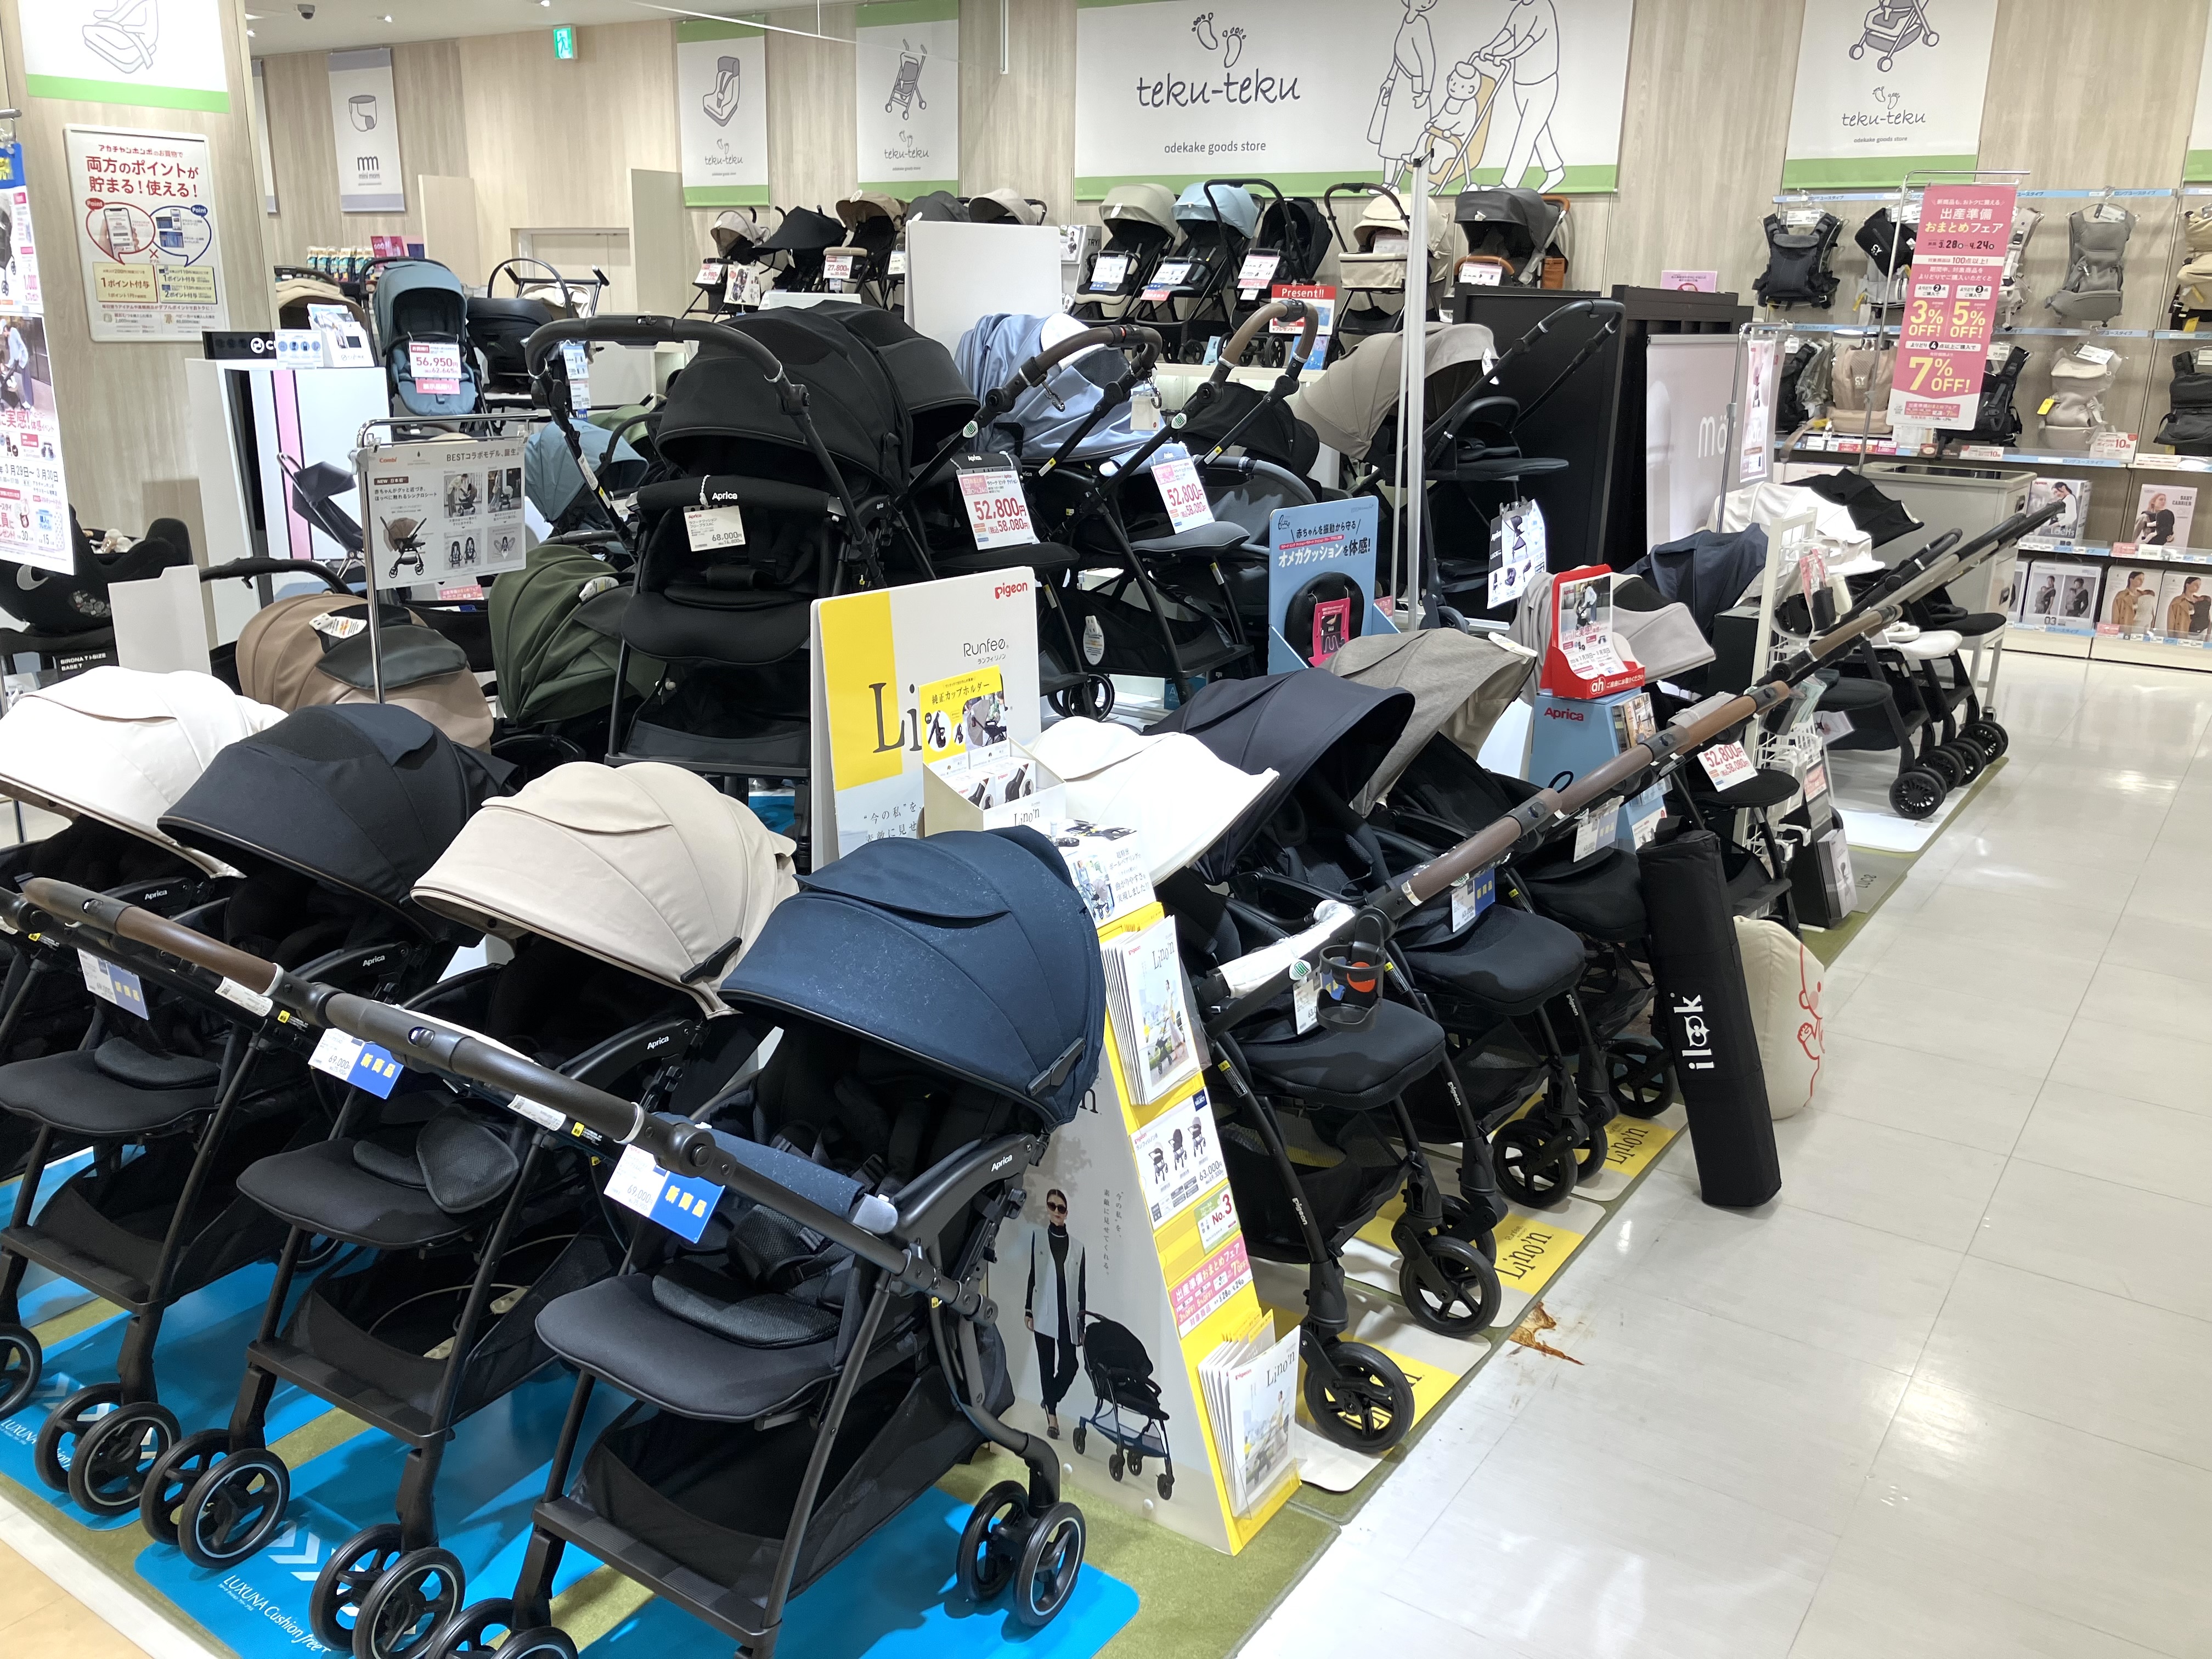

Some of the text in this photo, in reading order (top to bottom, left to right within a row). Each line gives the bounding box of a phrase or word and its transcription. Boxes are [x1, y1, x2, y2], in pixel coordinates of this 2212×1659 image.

[1137, 69, 1301, 108] teku-teku
[1842, 109, 1926, 126] teku-teku
[884, 147, 929, 160] teku-teku
[1164, 140, 1266, 155] odekake goods store
[86, 156, 199, 179] 両方のポイントが
[705, 155, 743, 166] teku-teku
[89, 176, 198, 198] 貯まる！使える！
[1940, 208, 1993, 220] 出産準備
[1925, 221, 2004, 234] おまとめフェア
[101, 278, 150, 289] 1ポイント付与
[1282, 287, 1324, 299] Present!!
[1910, 300, 1943, 324] 3%
[1952, 301, 1985, 326] 5%
[1909, 324, 1940, 337] OFF!
[1950, 326, 1983, 338] OFF!
[416, 357, 458, 368] 56,950円
[1909, 357, 1953, 391] 7%
[1931, 377, 1970, 392] OFF!
[447, 449, 520, 462] BESTコラボモデル、誕生。
[712, 492, 737, 501] Aprica
[1167, 483, 1204, 506] 52,800円
[973, 497, 1027, 521] 52,800円
[712, 532, 742, 541] 68,000円
[1296, 521, 1356, 539] 赤ちゃんを振動から守る
[1278, 538, 1371, 568] オメガクッションを体感！
[995, 582, 1028, 599] pigeon
[2044, 616, 2057, 625] 03
[964, 638, 1006, 657] Runfee
[932, 683, 990, 705] 純正カップホルダー
[1544, 707, 1584, 722] Aprica
[1703, 743, 1745, 768] 52,800円
[1014, 806, 1040, 827] Lino'n
[363, 955, 385, 966] Aprica
[1152, 939, 1175, 970] Lino'n
[647, 1036, 669, 1049] Aprica
[1606, 1127, 1649, 1165] Lino'n
[991, 1155, 1013, 1172] Aprica
[1199, 1160, 1222, 1181] 63,000円
[627, 1184, 653, 1205] 69,000円
[1493, 1231, 1552, 1280] Lino'n
[1266, 1351, 1295, 1389] Lino'n
[223, 1575, 269, 1611] LUXUNA
[264, 1606, 303, 1638] Cushion
